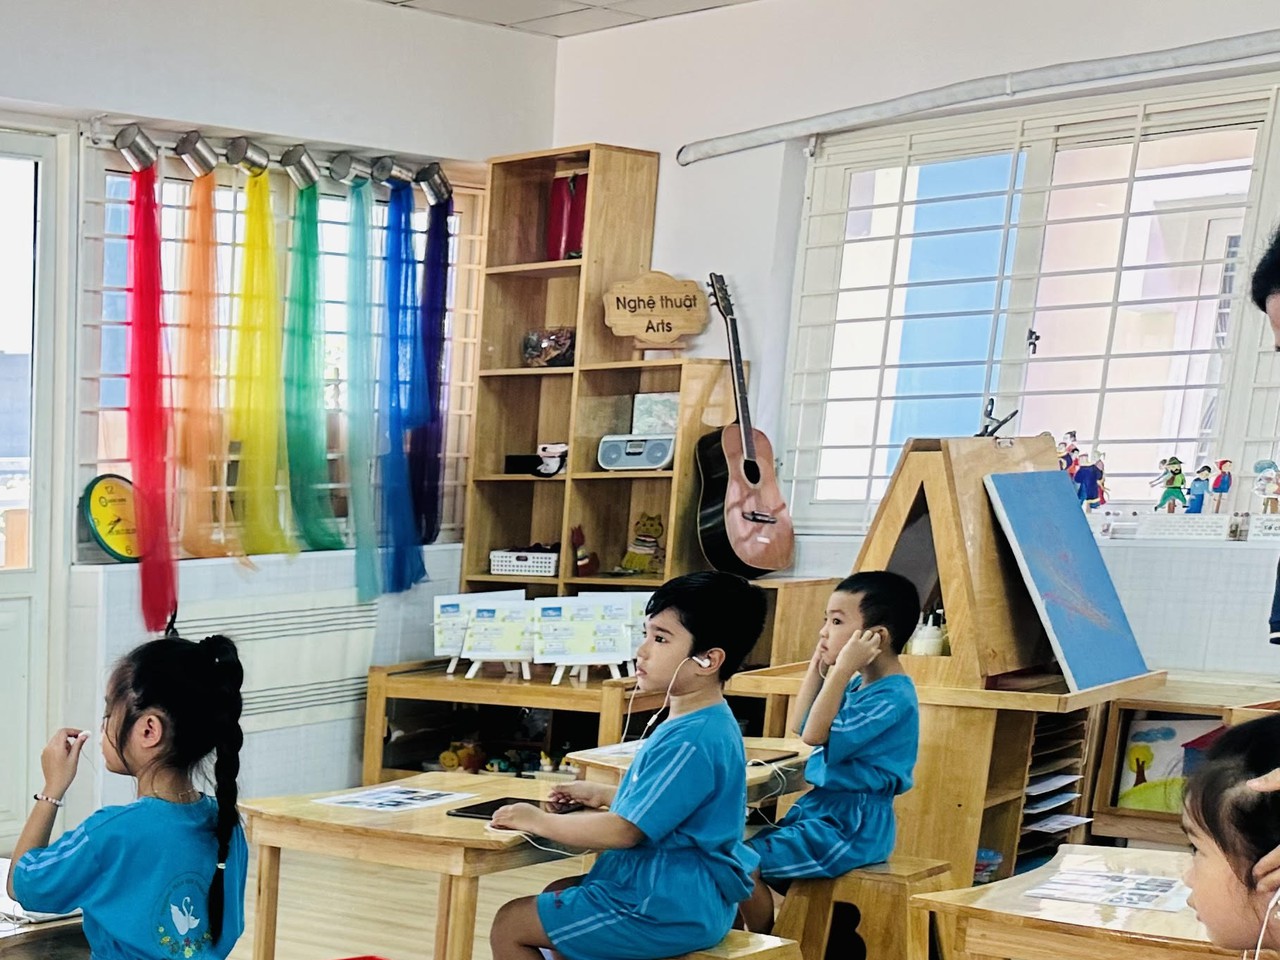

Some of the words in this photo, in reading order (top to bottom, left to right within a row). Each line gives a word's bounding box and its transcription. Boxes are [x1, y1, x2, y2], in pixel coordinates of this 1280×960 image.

[616, 295, 656, 313] Nghệ
[660, 294, 697, 311] thuật
[645, 319, 673, 333] Arts
